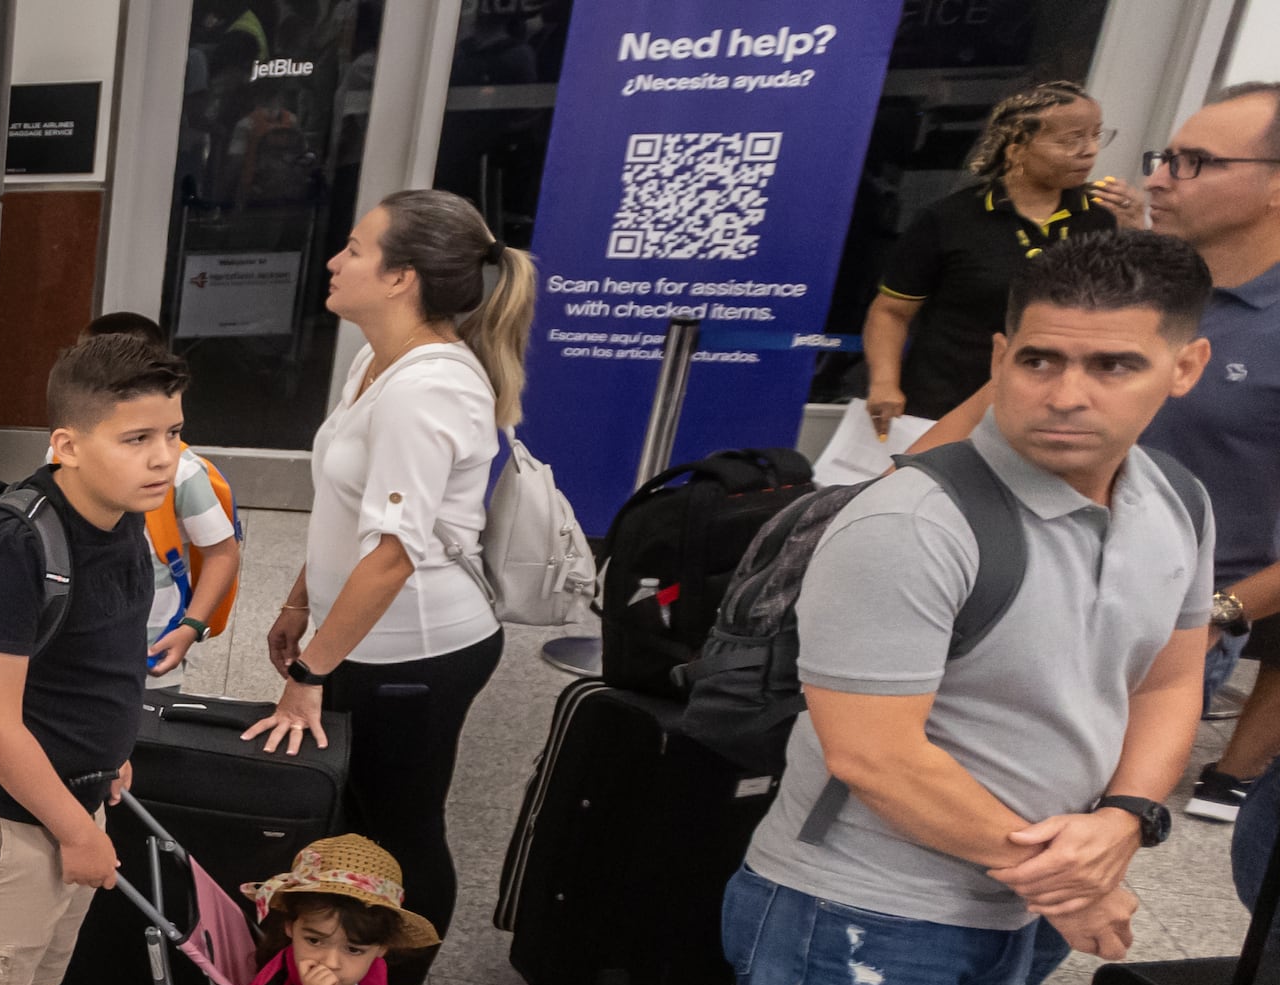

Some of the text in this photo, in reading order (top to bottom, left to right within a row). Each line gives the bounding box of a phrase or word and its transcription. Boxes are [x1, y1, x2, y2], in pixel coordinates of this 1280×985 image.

[618, 24, 837, 63] Need help?
[250, 58, 314, 81] jetBlue
[621, 69, 816, 96] ¿Necesita ayuda?
[42, 121, 75, 129] AIRLINES
[44, 128, 73, 136] SERVICE
[547, 275, 808, 297] Scan here for assistance
[566, 300, 777, 320] with checked items.
[549, 329, 666, 345] Escanee aquí par
[792, 333, 843, 348] jetBlue
[563, 347, 590, 357] con
[592, 346, 613, 358] los
[690, 351, 760, 363] cturados.
